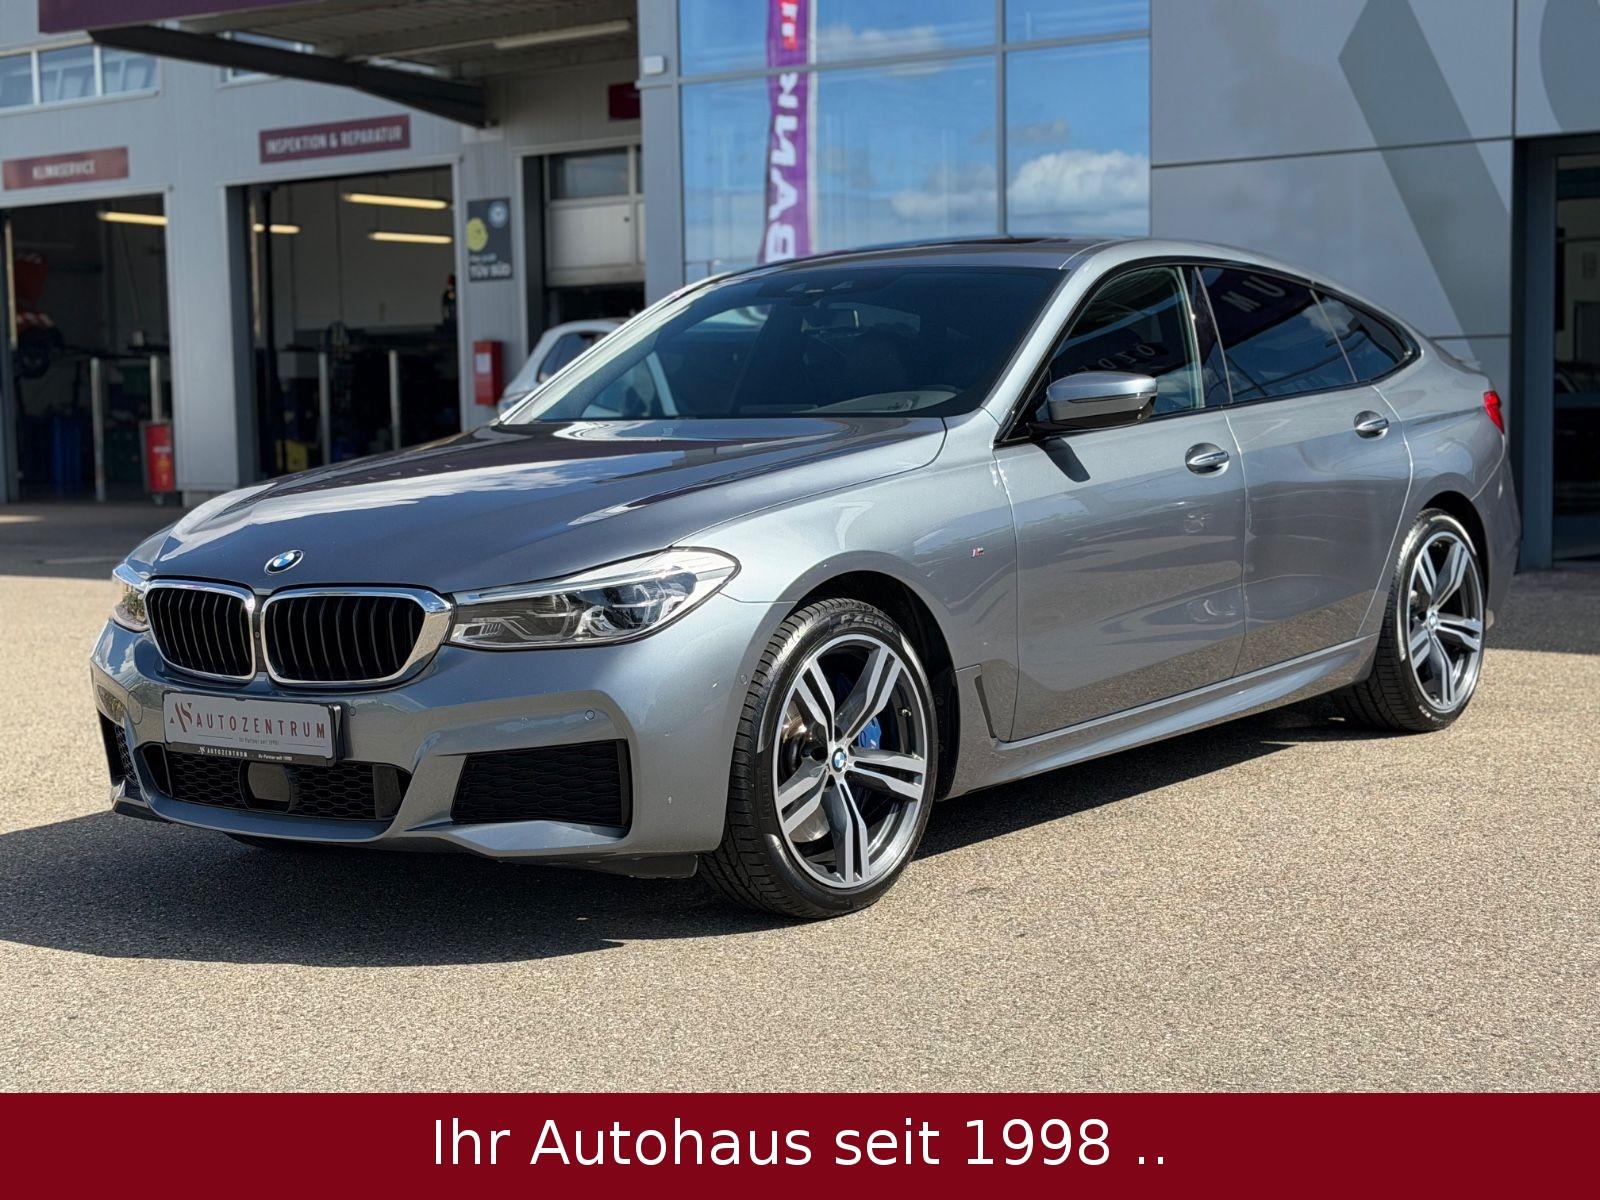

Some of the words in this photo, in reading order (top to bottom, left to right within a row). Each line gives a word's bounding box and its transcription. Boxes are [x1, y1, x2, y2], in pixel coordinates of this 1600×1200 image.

[329, 131, 338, 149] &
[196, 712, 325, 740] AUTOZENTRUM
[207, 748, 248, 758] AUTOZENTRUM
